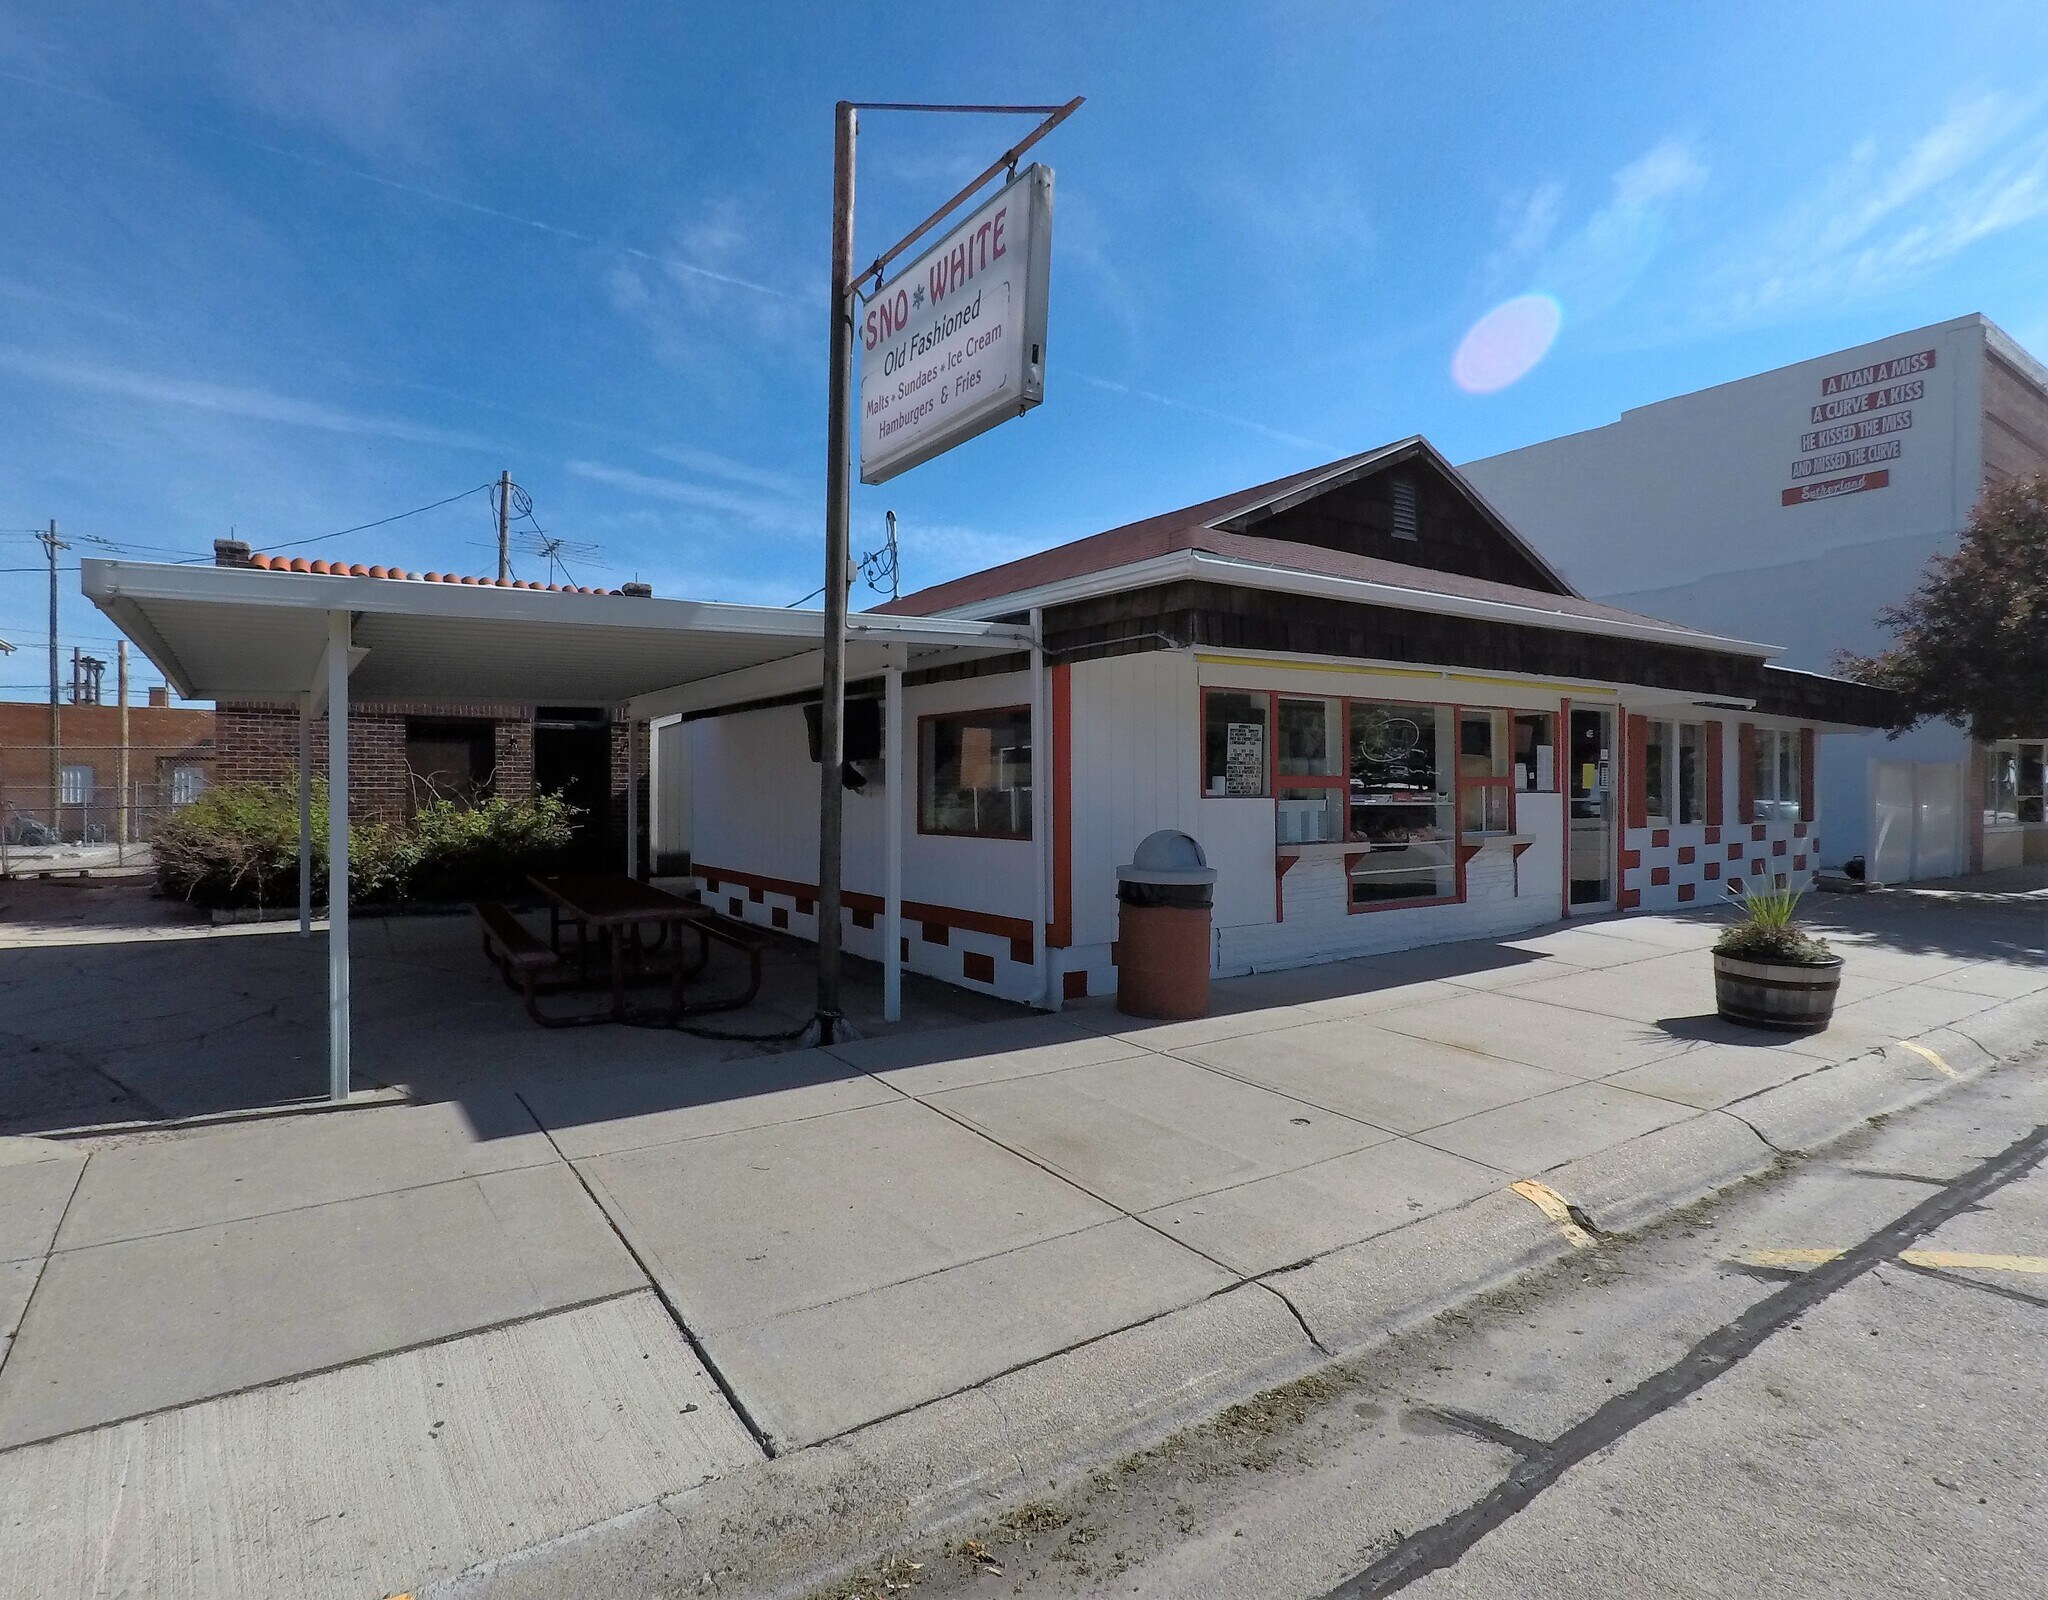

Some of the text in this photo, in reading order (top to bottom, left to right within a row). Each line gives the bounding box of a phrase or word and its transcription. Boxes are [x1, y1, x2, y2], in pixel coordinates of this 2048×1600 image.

[866, 207, 1007, 350] SNO WHITE
[884, 289, 981, 377] Old Fashioned
[866, 323, 1002, 418] Malts Sundaes Ice Cream
[1827, 353, 1928, 393] A MAN A MISS
[879, 369, 982, 439] Hamburgers & Fries
[1813, 382, 1922, 422] A CURVE A KISS
[1802, 412, 1911, 450] HE KISSED THE MISS
[1793, 441, 1899, 478] AND MISSED THE CURVE
